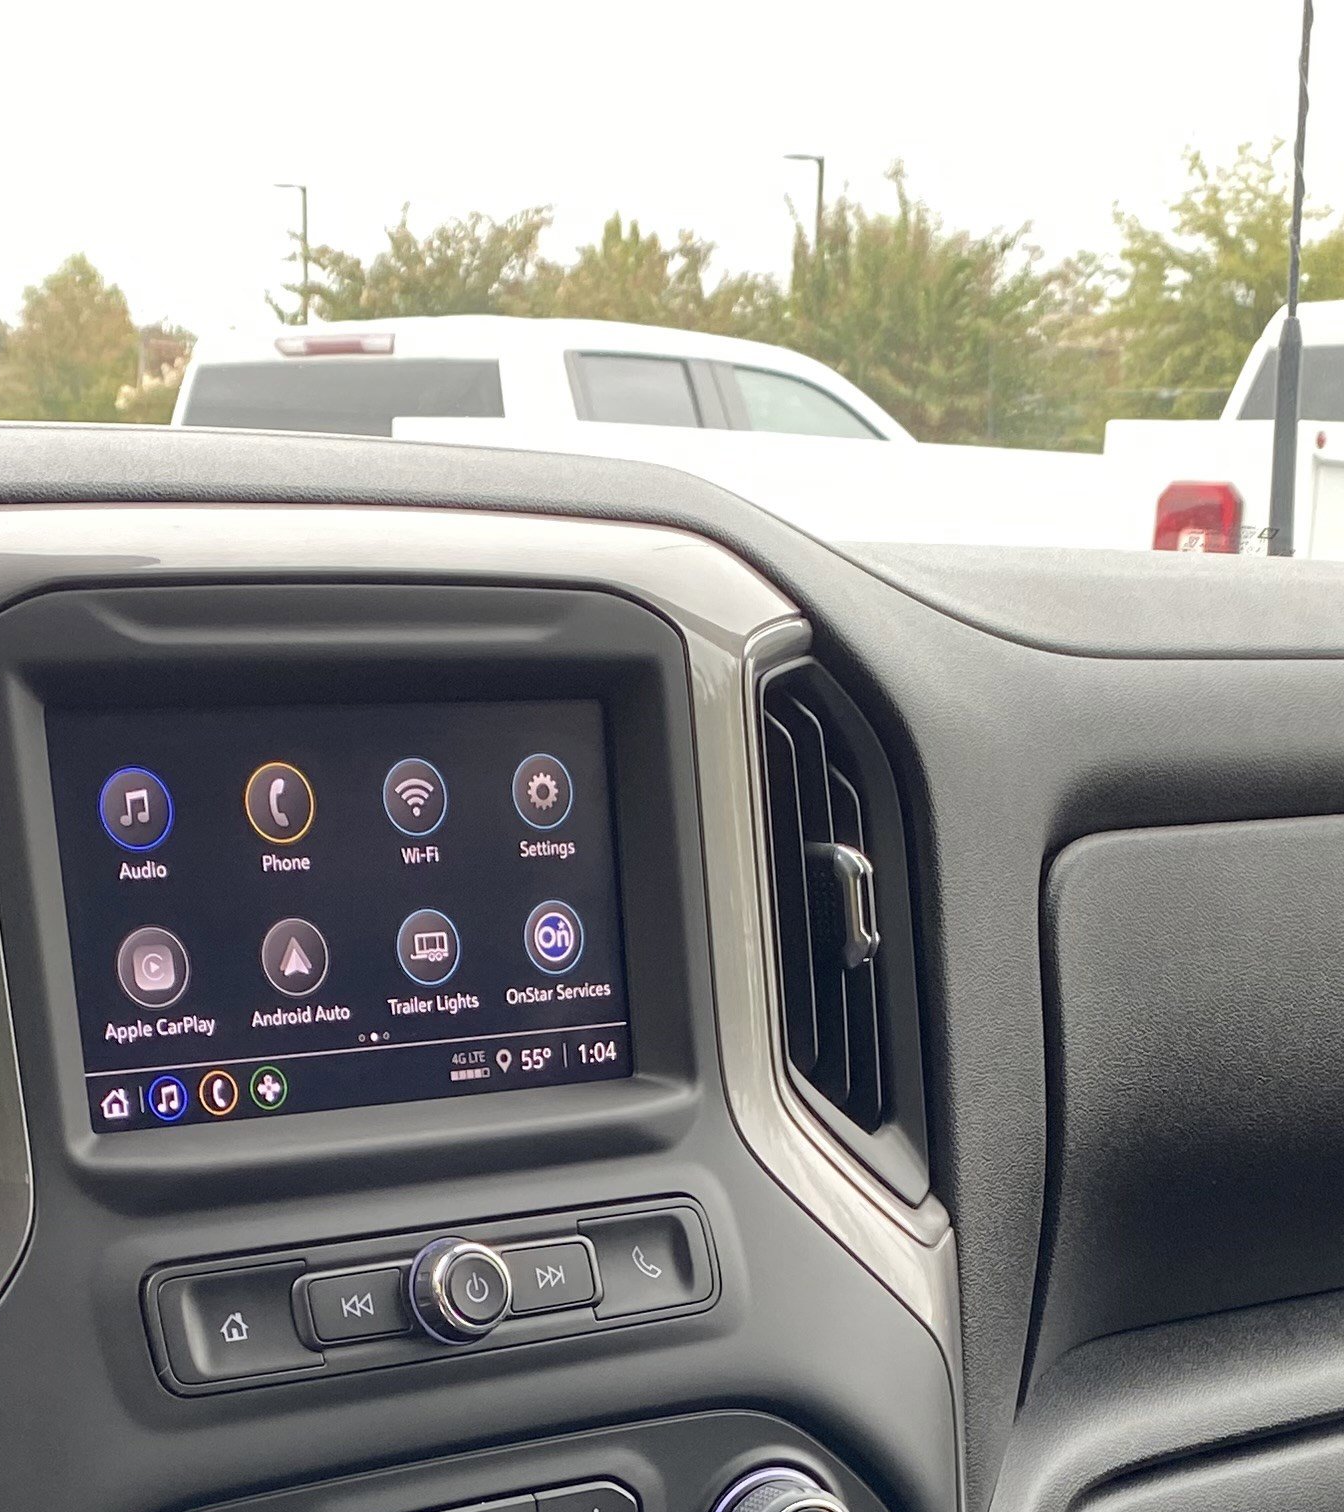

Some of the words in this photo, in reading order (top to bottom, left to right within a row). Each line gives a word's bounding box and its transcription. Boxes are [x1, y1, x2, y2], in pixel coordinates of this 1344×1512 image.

[401, 847, 439, 864] Wi-Fi
[519, 840, 575, 859] Settings
[119, 861, 167, 880] Audio
[262, 853, 311, 872] Phone
[506, 985, 552, 1004] OnStar
[555, 981, 611, 1000] Services
[388, 996, 430, 1015] Trailer
[434, 993, 479, 1014] Lights
[252, 1007, 311, 1026] Android
[314, 1004, 350, 1022] Auto
[105, 1022, 153, 1042] Apple
[155, 1018, 215, 1039] CarPlay
[451, 1052, 467, 1065] 4G
[468, 1050, 486, 1064] LTE
[577, 1041, 616, 1063] 1:04
